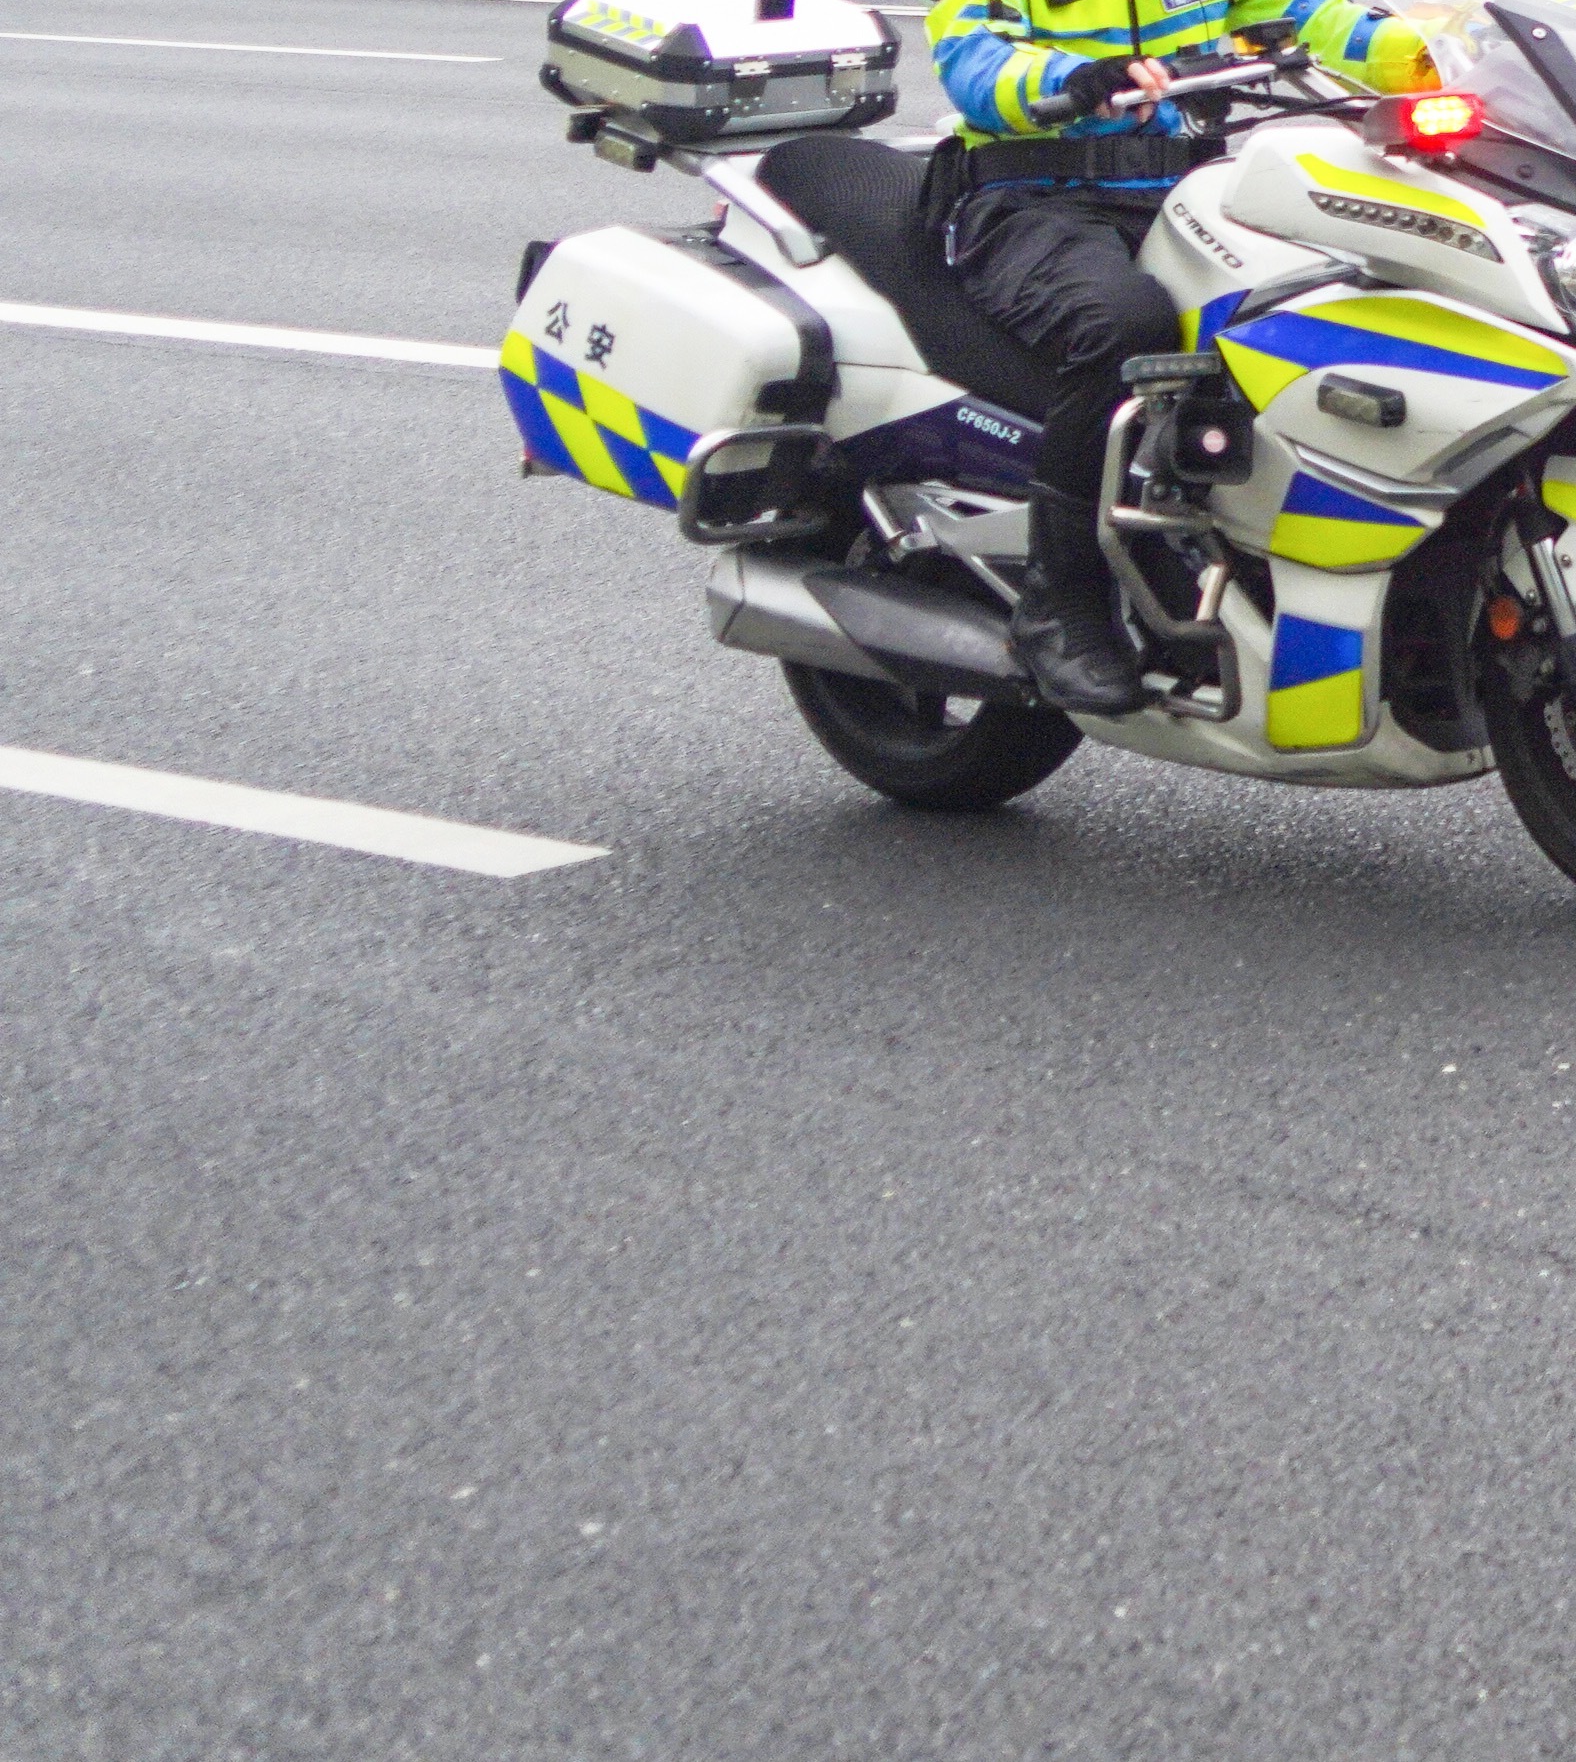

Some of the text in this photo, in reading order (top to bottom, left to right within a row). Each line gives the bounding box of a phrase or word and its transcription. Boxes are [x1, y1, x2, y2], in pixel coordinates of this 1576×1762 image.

[1173, 202, 1243, 269] CFMOTO
[545, 301, 616, 370] 公安
[957, 406, 1022, 445] CF650J-2
